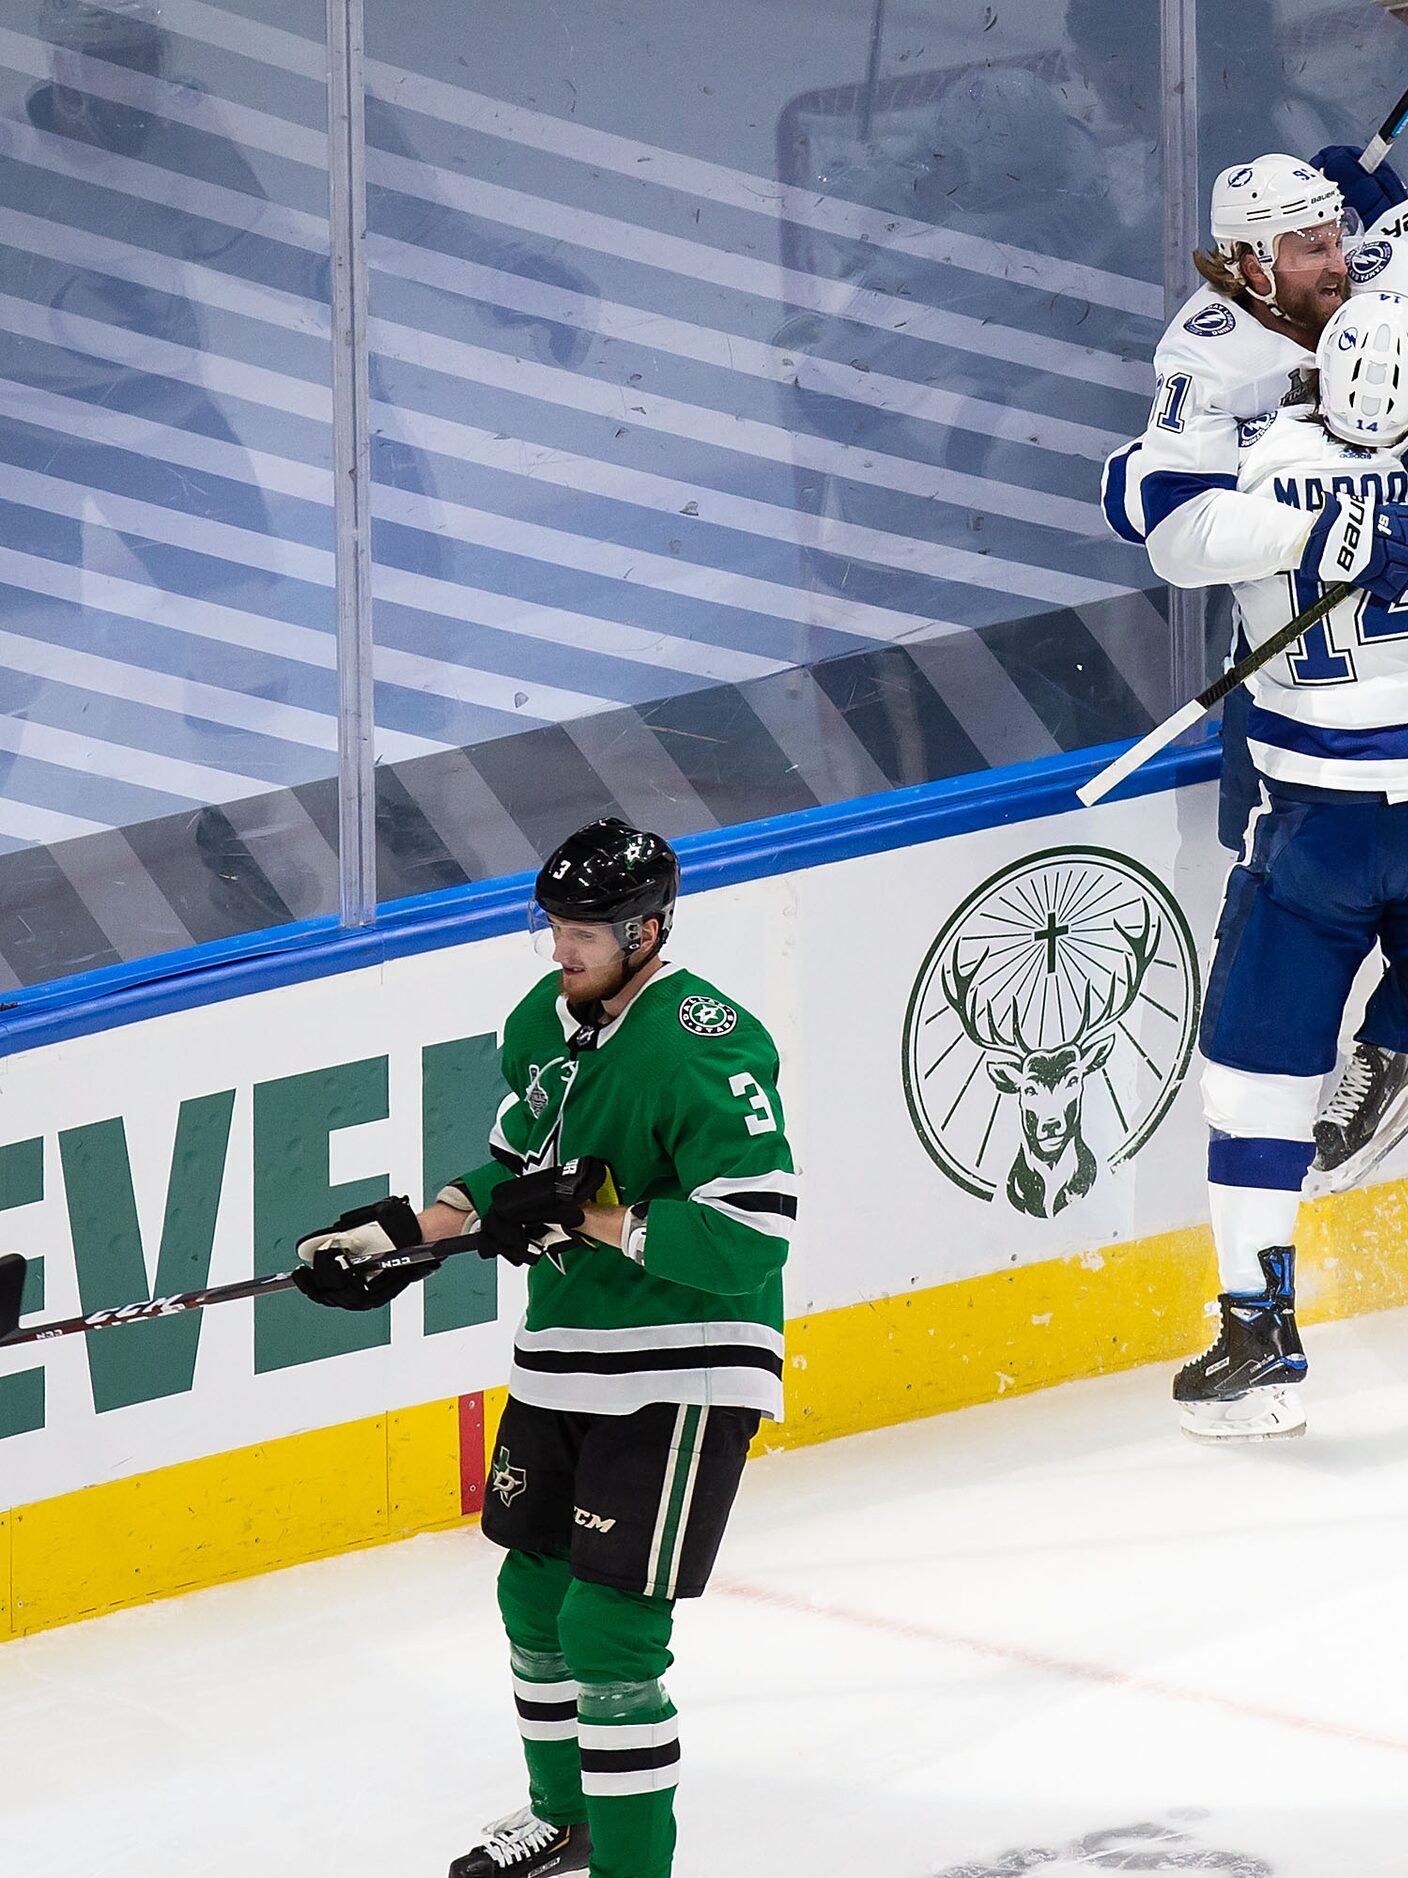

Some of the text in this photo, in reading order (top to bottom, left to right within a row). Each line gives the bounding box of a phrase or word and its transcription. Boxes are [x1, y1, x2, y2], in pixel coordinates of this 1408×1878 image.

[1152, 372, 1193, 434] 1
[1355, 419, 1379, 432] 14
[552, 859, 572, 880] 3
[727, 1071, 777, 1137] 3
